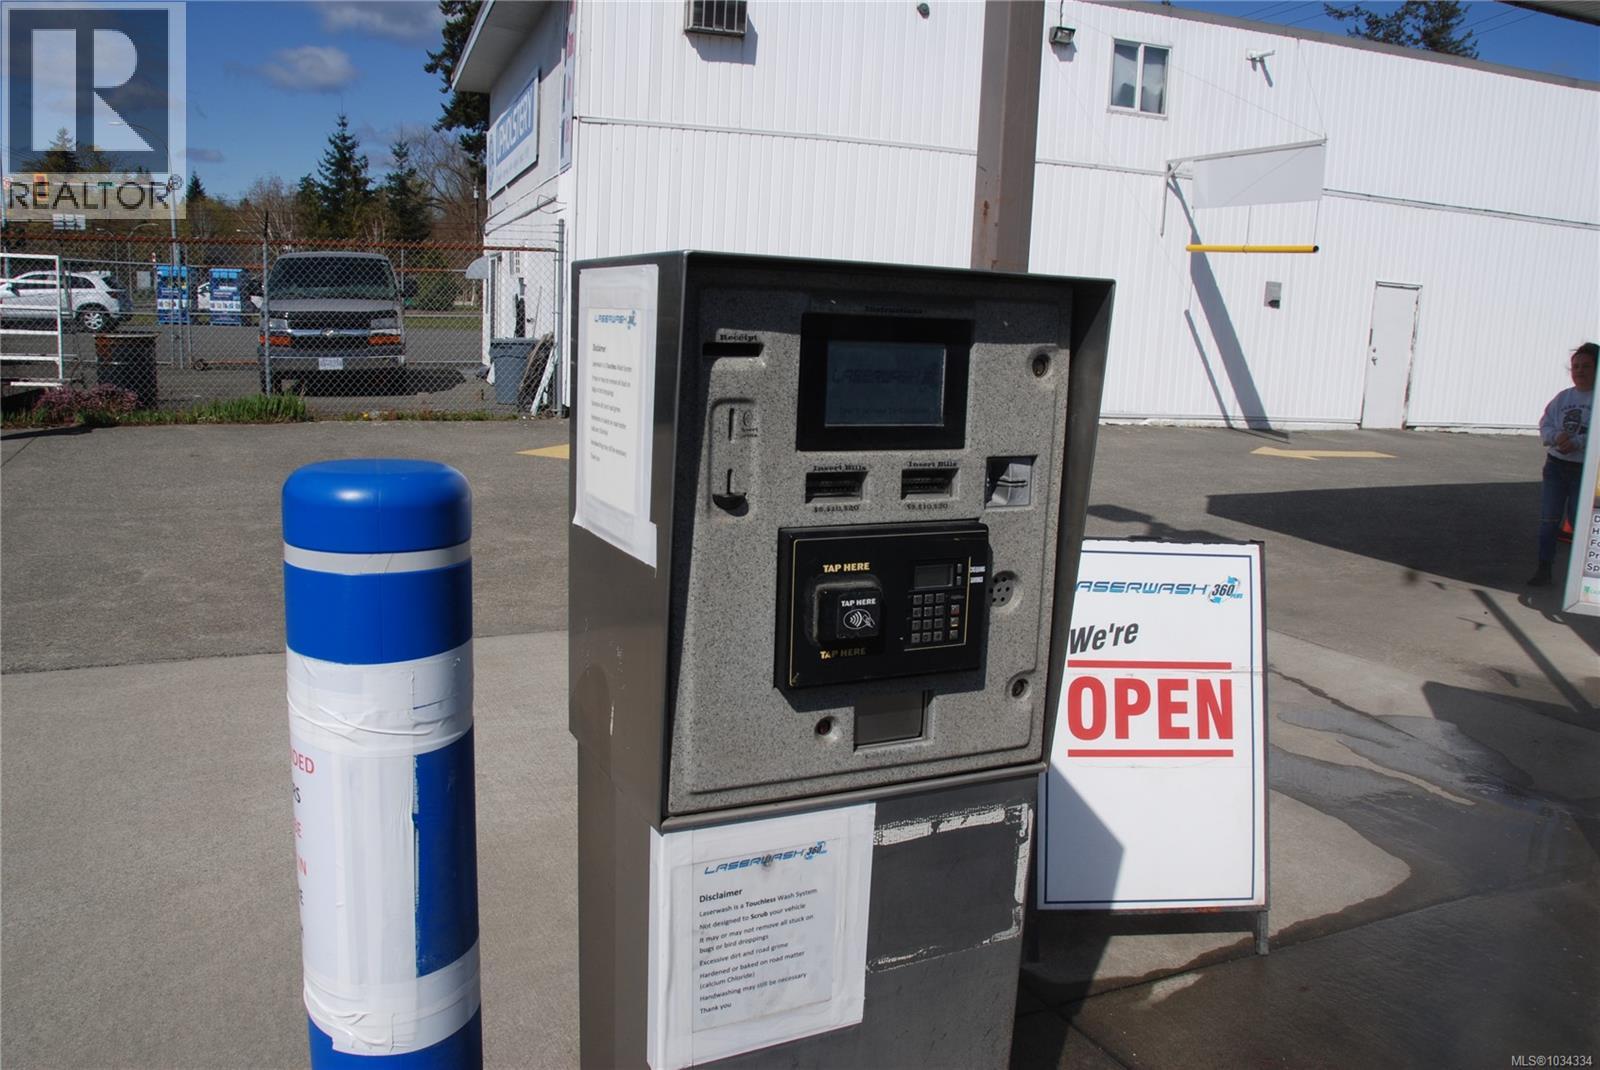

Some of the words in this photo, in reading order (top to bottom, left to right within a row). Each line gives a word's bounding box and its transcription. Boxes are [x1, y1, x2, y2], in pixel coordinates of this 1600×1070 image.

[720, 334, 758, 342] Receipt
[812, 464, 843, 472] Insert
[844, 463, 867, 471] Bills
[907, 460, 937, 468] Insert
[822, 563, 842, 573] TAP
[843, 562, 871, 572] HERE
[1076, 581, 1208, 596] ASERWASH
[1211, 583, 1236, 597] 360
[856, 598, 877, 606] HERE
[1069, 622, 1139, 655] We're
[819, 649, 839, 660] TAP
[840, 647, 866, 657] HERE
[1067, 676, 1234, 741] OPEN
[699, 889, 743, 903] Disclaimer
[699, 905, 733, 917] Laserwash
[745, 897, 776, 907] Touchless
[777, 892, 796, 901] Wash
[795, 889, 818, 899] System
[699, 922, 711, 930] Not
[712, 916, 741, 928] designed
[750, 911, 768, 920] Scrub
[769, 908, 784, 917] your
[784, 903, 806, 912] vehicle
[705, 934, 720, 942] may
[729, 929, 743, 937] may
[755, 922, 780, 931] remove
[780, 918, 788, 926] all
[789, 916, 804, 924] stuck
[699, 946, 715, 954] bugs
[724, 940, 737, 948] bird
[738, 934, 769, 946] droppings
[699, 956, 729, 967] Excessive
[730, 952, 741, 960] dirt
[742, 949, 754, 957] and
[755, 945, 770, 954] road
[770, 942, 789, 952] grime
[699, 967, 731, 979] Hardened
[739, 961, 759, 970] baked
[769, 955, 784, 963] road
[784, 951, 806, 960] matter
[699, 978, 726, 990] (calcium
[727, 971, 756, 983] Chloride)
[699, 987, 741, 1001] Handwashing
[742, 984, 756, 992] may
[757, 980, 768, 988] still
[777, 972, 807, 983] necessary
[699, 1004, 719, 1014] Thank
[719, 1002, 732, 1010] you
